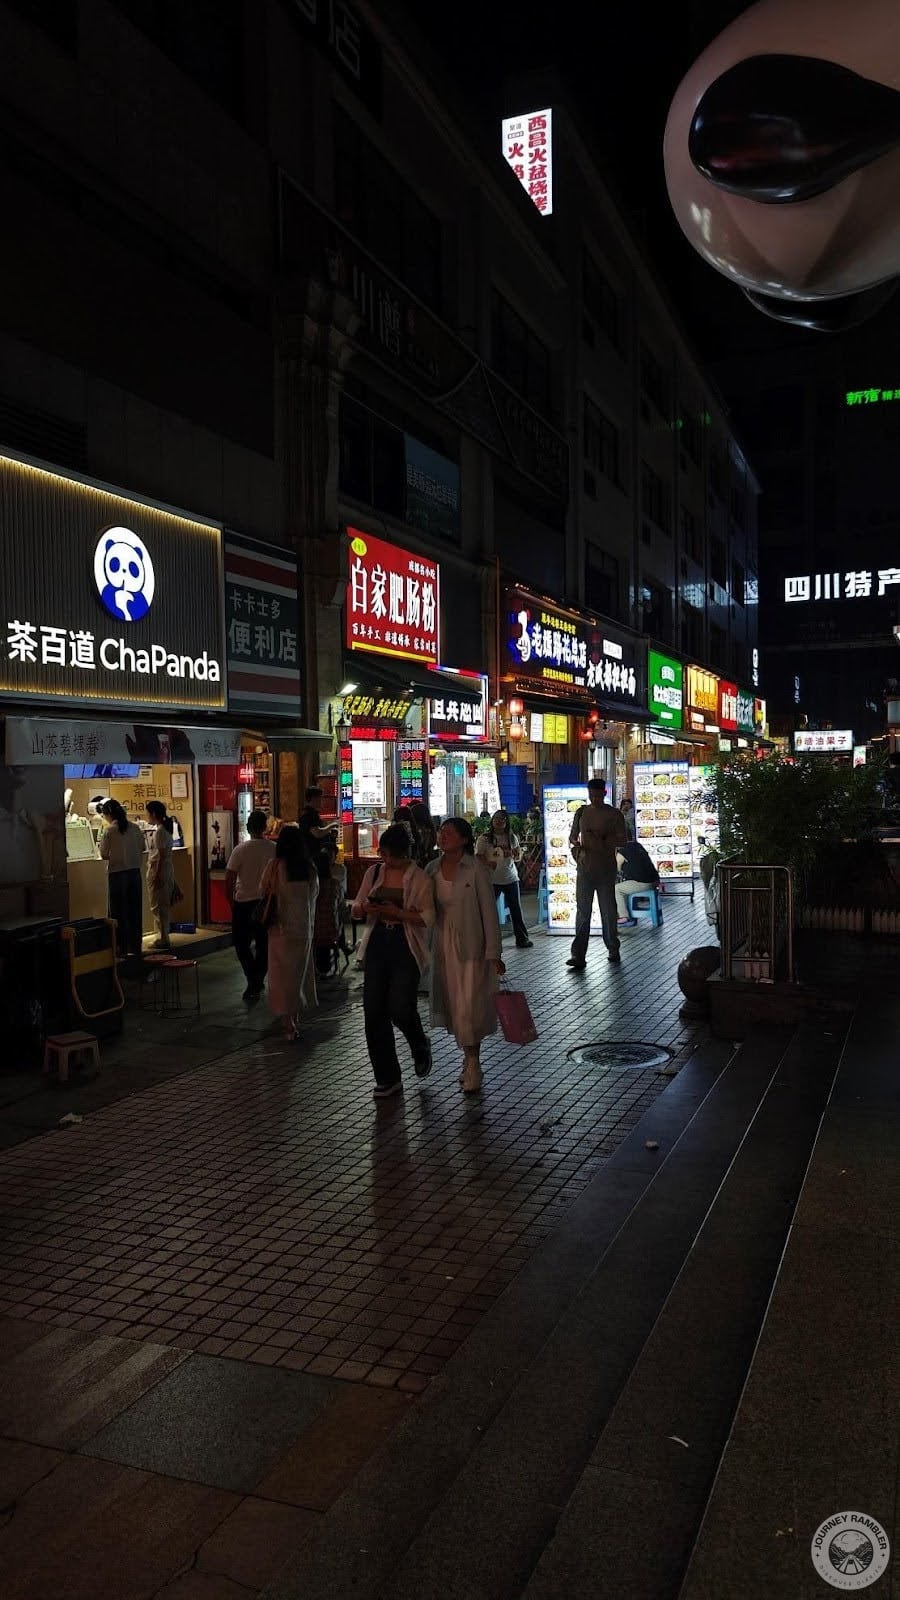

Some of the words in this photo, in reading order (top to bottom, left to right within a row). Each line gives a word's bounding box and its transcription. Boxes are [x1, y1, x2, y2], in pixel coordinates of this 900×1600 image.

[229, 588, 281, 620] 卡卡士多
[351, 557, 436, 633] 白家肥肠粉
[785, 568, 900, 602] 四川特产
[7, 620, 95, 669] 茶百道
[100, 638, 220, 681] ChaPanda
[228, 618, 297, 662] 便利店
[133, 783, 169, 798] 茶百道
